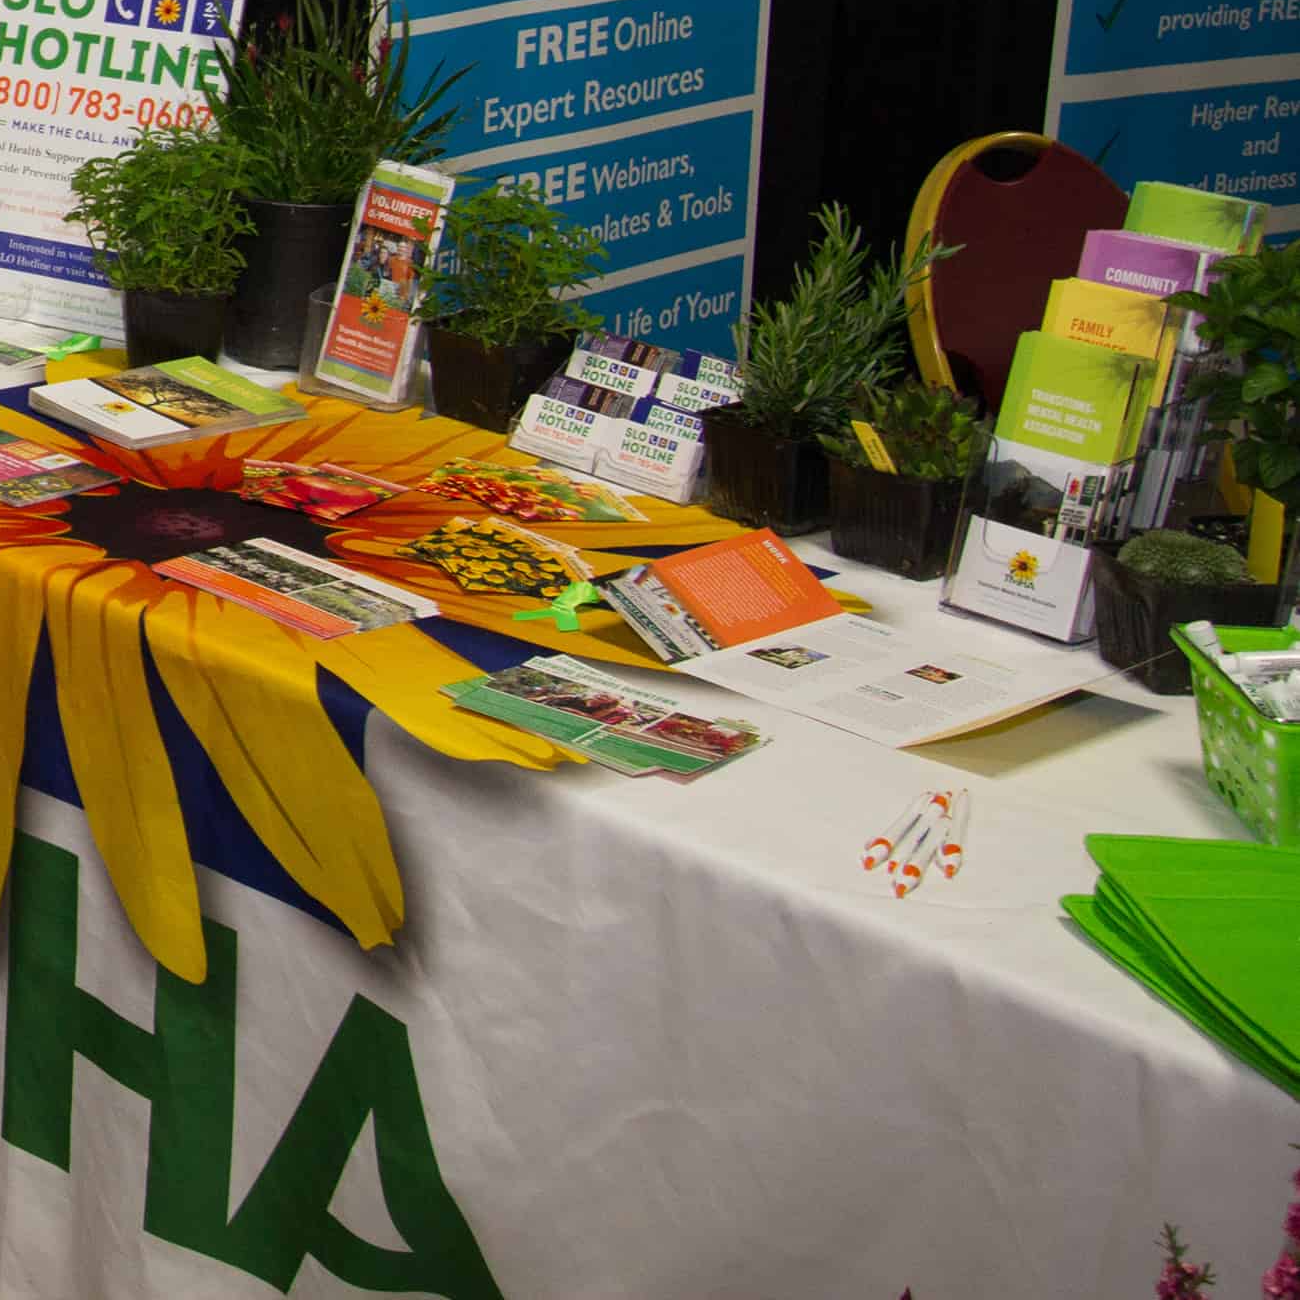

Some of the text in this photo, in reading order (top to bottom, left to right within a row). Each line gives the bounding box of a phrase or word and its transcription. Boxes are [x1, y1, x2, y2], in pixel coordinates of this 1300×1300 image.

[205, 19, 217, 31] 7
[515, 10, 694, 70] FREE Online
[68, 86, 213, 131] 783-0607
[483, 66, 705, 138] Expert Resources
[1191, 99, 1259, 131] Higher
[11, 119, 45, 135] MAKE
[49, 124, 73, 139] THE
[9, 139, 42, 157] Health
[1242, 132, 1280, 157] and
[22, 163, 73, 184] Preventio
[591, 152, 696, 196] Webinars,
[1214, 169, 1297, 196] Business
[656, 199, 674, 229] &
[680, 184, 734, 223] Tools
[8, 237, 55, 259] Interested
[56, 247, 67, 259] in
[17, 255, 52, 273] Hotline
[52, 264, 65, 275] or
[66, 264, 87, 279] visit
[1104, 267, 1179, 294] COMMUNITY
[614, 288, 736, 339] Life of Your
[1070, 317, 1114, 340] FAMILY
[585, 355, 609, 371] SLO
[701, 357, 724, 373] SLO
[579, 367, 636, 393] HOTLINE
[677, 381, 700, 397] SLO
[541, 399, 565, 415] SLO
[651, 407, 673, 422] SLO
[1028, 404, 1101, 435] MENTAL HEALTH
[536, 412, 591, 438] HOTLINE
[624, 426, 649, 443] SLO
[621, 440, 674, 465] HOTLINE
